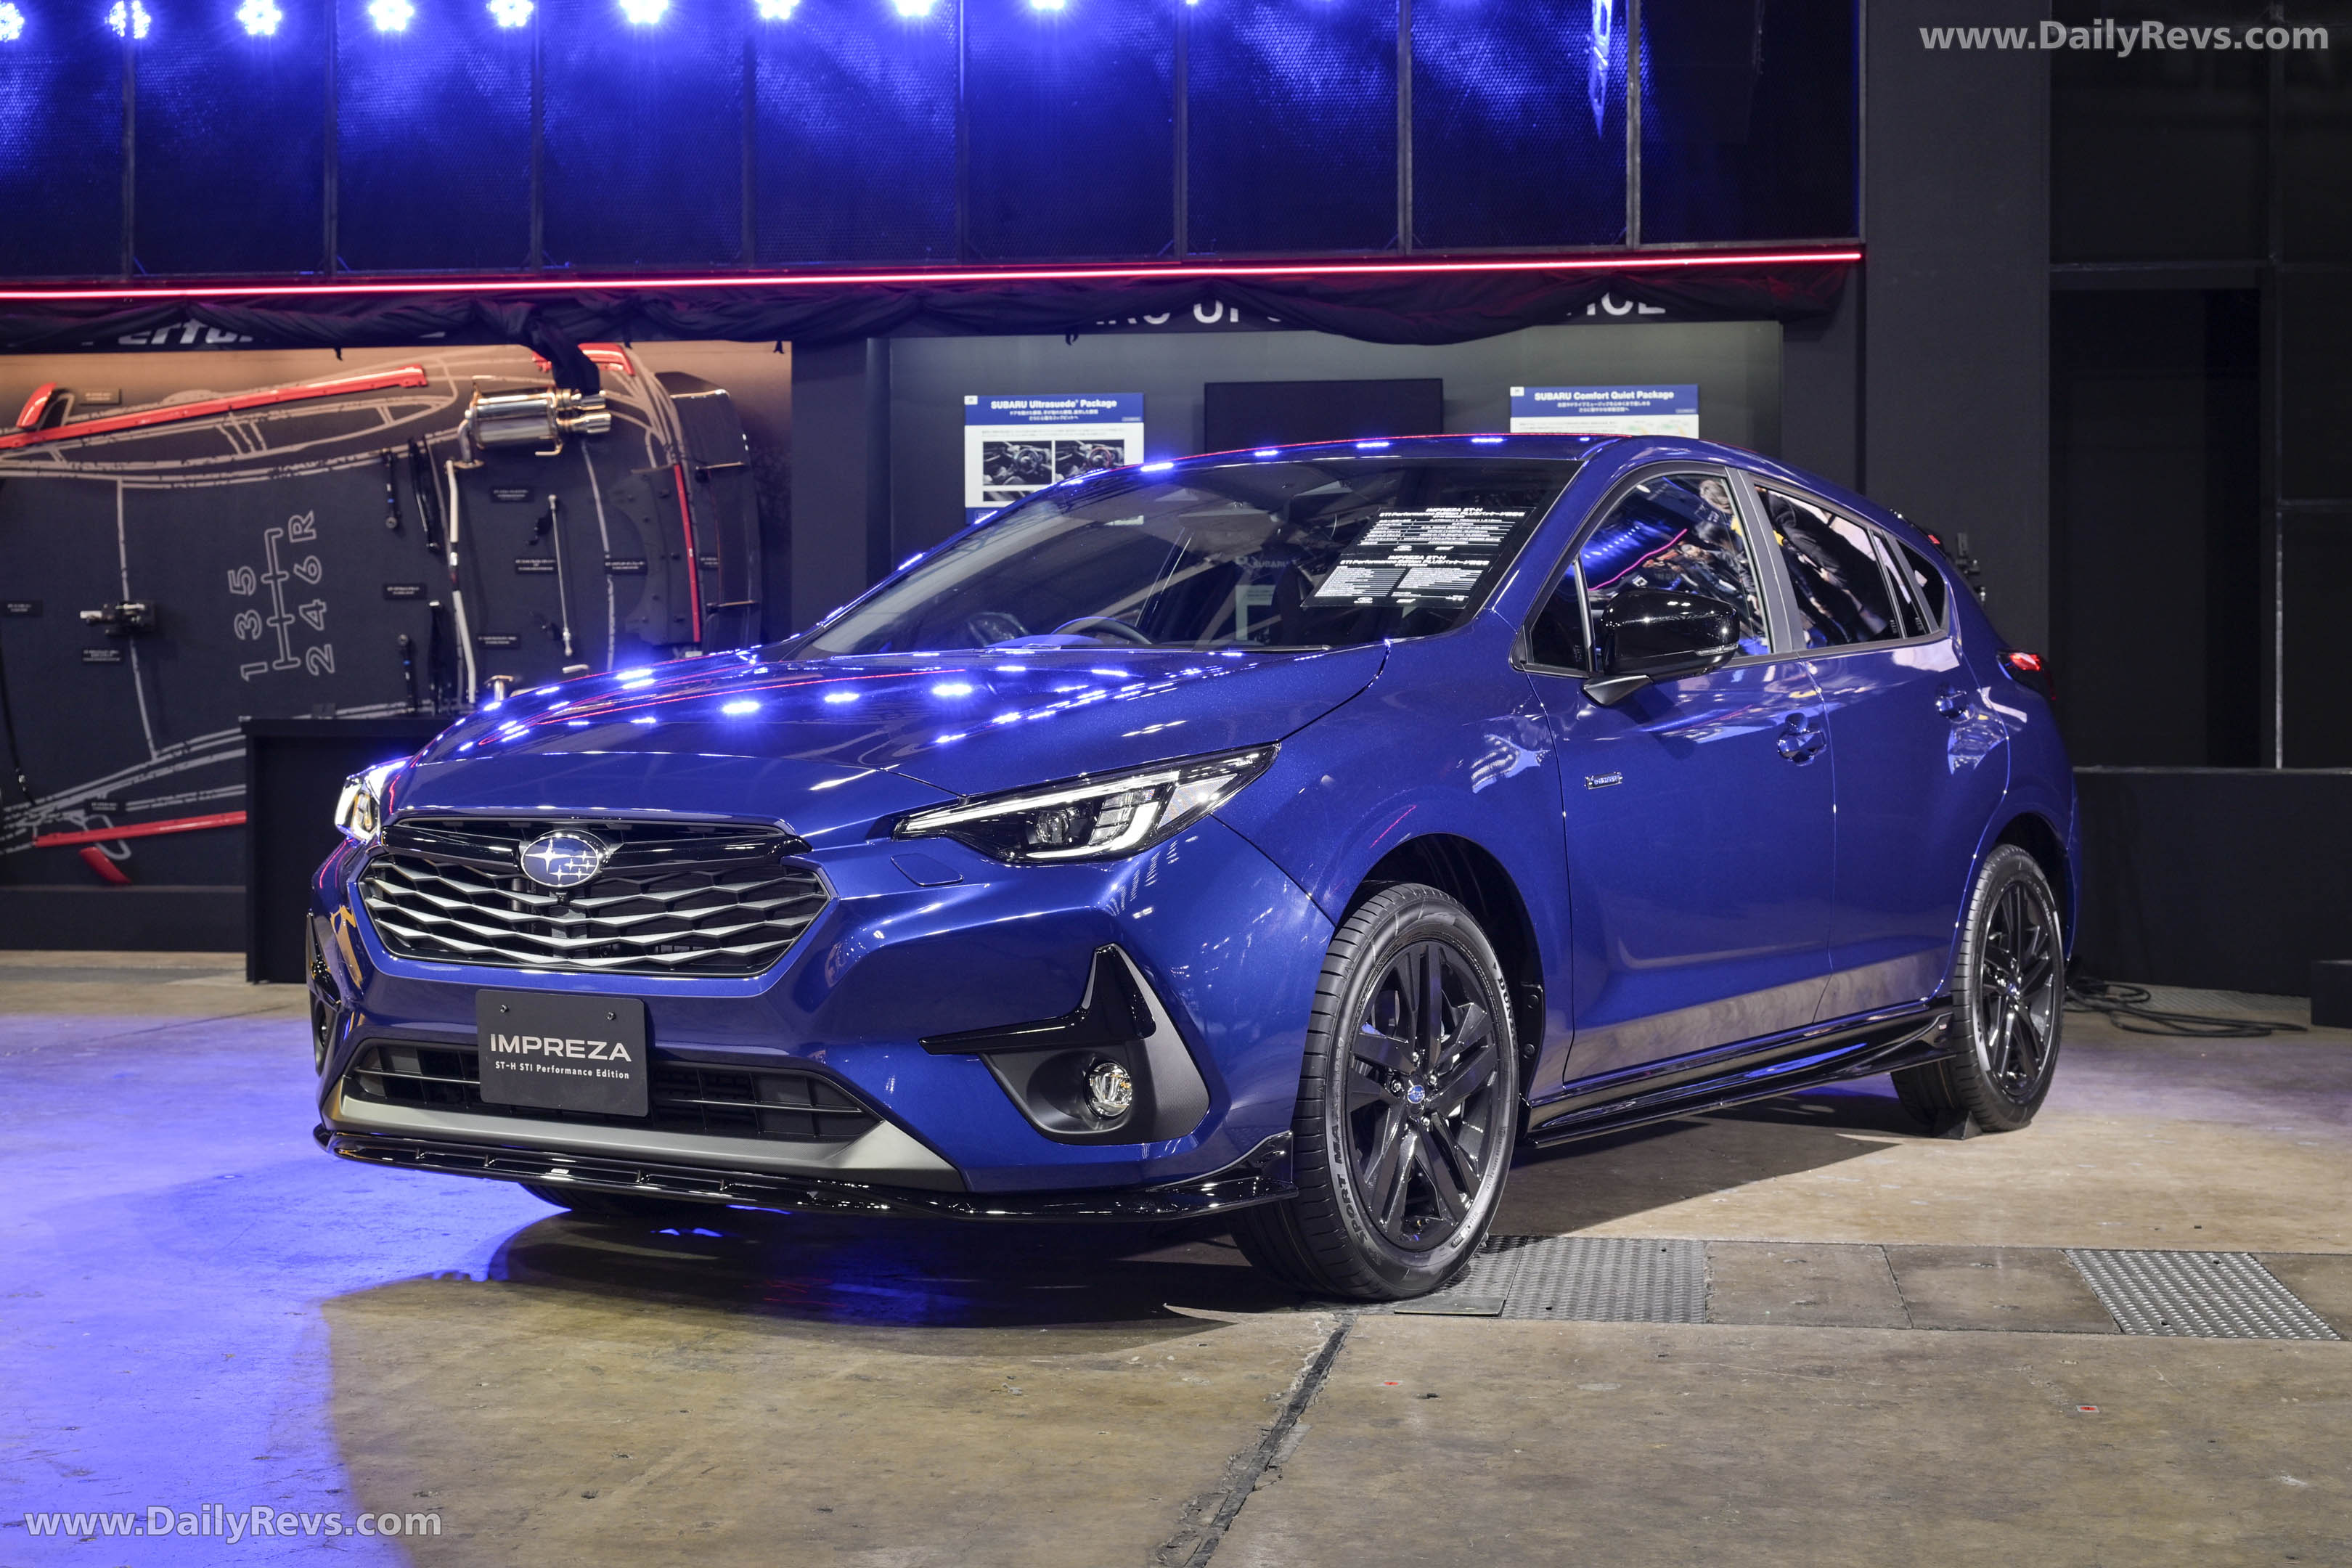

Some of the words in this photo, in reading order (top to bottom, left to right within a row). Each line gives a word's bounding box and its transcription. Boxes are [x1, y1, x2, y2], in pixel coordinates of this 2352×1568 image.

[991, 400, 1028, 409] SUBARU
[1080, 399, 1117, 409] Package
[1535, 392, 1572, 401] SUBARU
[1574, 391, 1609, 400] Comfort
[1611, 391, 1635, 400] Quiet
[1637, 391, 1674, 400] Package
[287, 510, 317, 543] R
[227, 565, 256, 597] 5
[293, 555, 322, 584] 6
[234, 609, 263, 640] 3
[298, 598, 327, 631] 4
[306, 644, 335, 676] 2
[490, 1033, 632, 1062] IMPREZA
[495, 1061, 517, 1071] ST-H
[519, 1063, 533, 1072] STI
[536, 1064, 592, 1077] Performance
[596, 1069, 629, 1079] Edition
